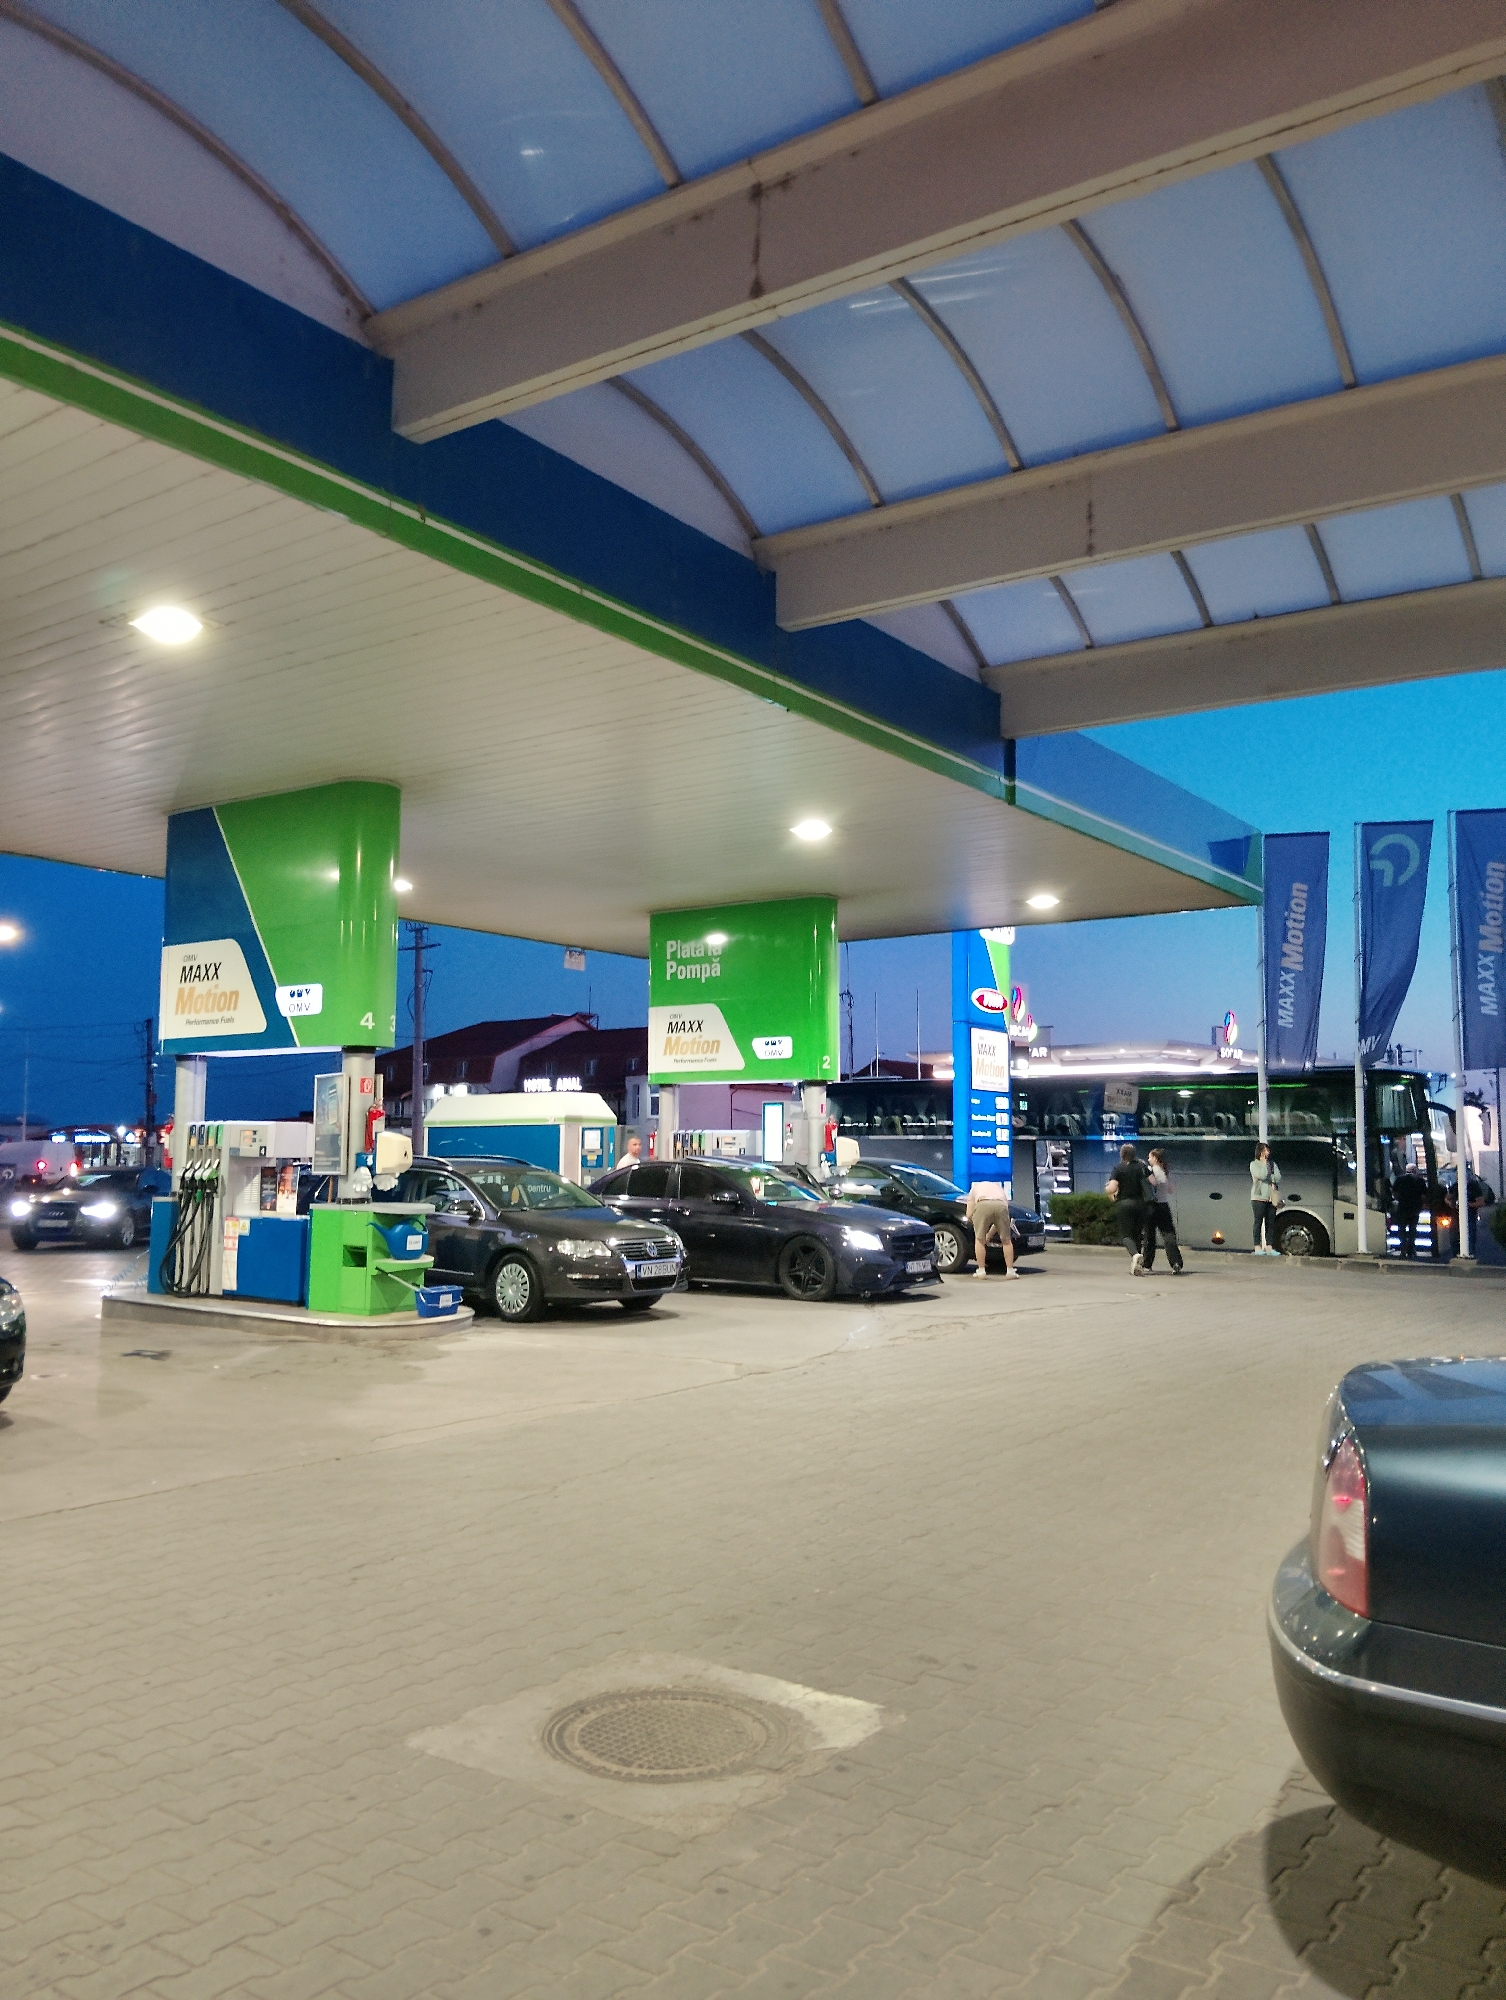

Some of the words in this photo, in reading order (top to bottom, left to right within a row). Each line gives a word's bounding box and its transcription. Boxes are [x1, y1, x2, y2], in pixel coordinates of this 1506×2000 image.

[1478, 862, 1506, 953] Motion
[1281, 882, 1309, 972] Motion
[183, 954, 198, 963] OMV
[666, 939, 705, 960] Plata
[179, 962, 222, 984] MAXX
[666, 957, 721, 983] Pompă
[1478, 953, 1499, 1016] MAXX
[174, 984, 240, 1015] Motion
[288, 1002, 311, 1013] OMV
[1278, 970, 1296, 1029] MAXX
[185, 1018, 220, 1027] Performance
[220, 1016, 235, 1025] Fuels
[360, 1012, 375, 1030] 4
[667, 1020, 704, 1034] MAXX
[663, 1034, 721, 1056] Motion
[764, 1049, 784, 1057] OMV
[977, 1043, 997, 1057] MAXX
[1358, 1033, 1382, 1058] MV
[822, 1055, 831, 1070] 2
[975, 1057, 1005, 1079] Motion
[527, 1183, 551, 1193] pentru
